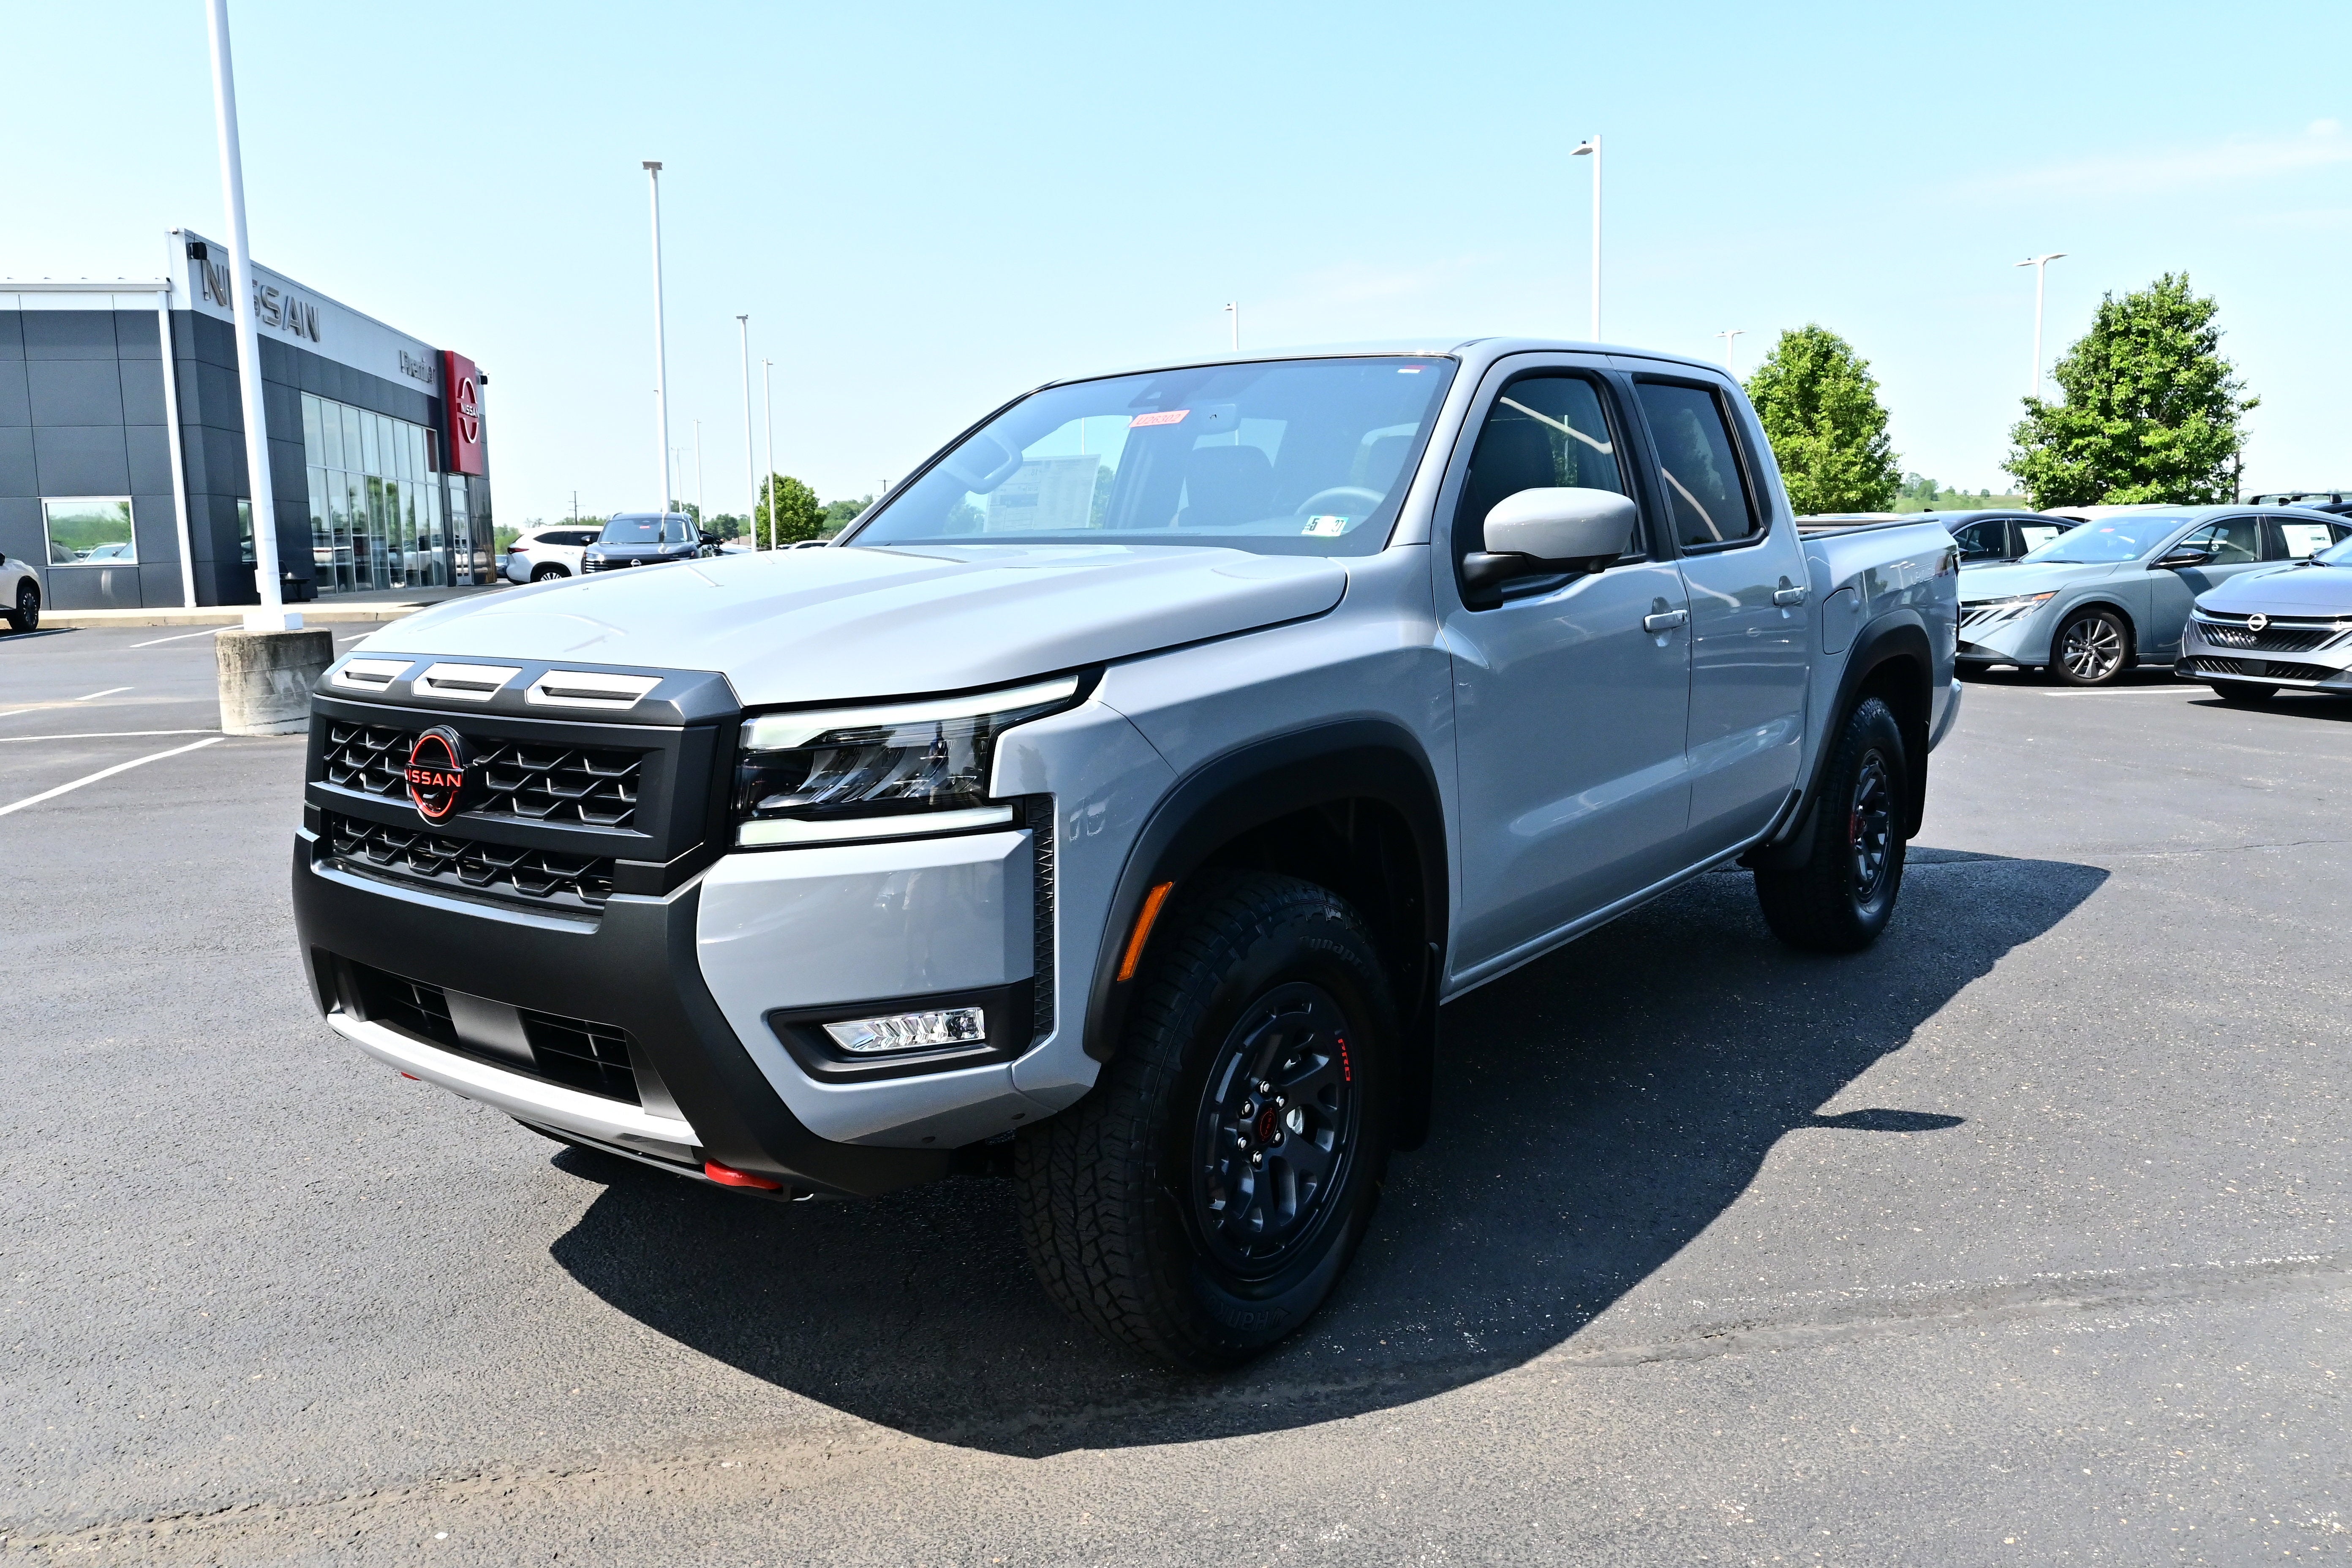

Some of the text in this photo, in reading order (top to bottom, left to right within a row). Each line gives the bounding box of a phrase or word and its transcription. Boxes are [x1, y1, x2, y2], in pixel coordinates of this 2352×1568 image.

[461, 403, 479, 418] NISSAN
[1136, 414, 1181, 425] U26302
[1309, 518, 1320, 531] 5
[1338, 1039, 1350, 1081] PRO
